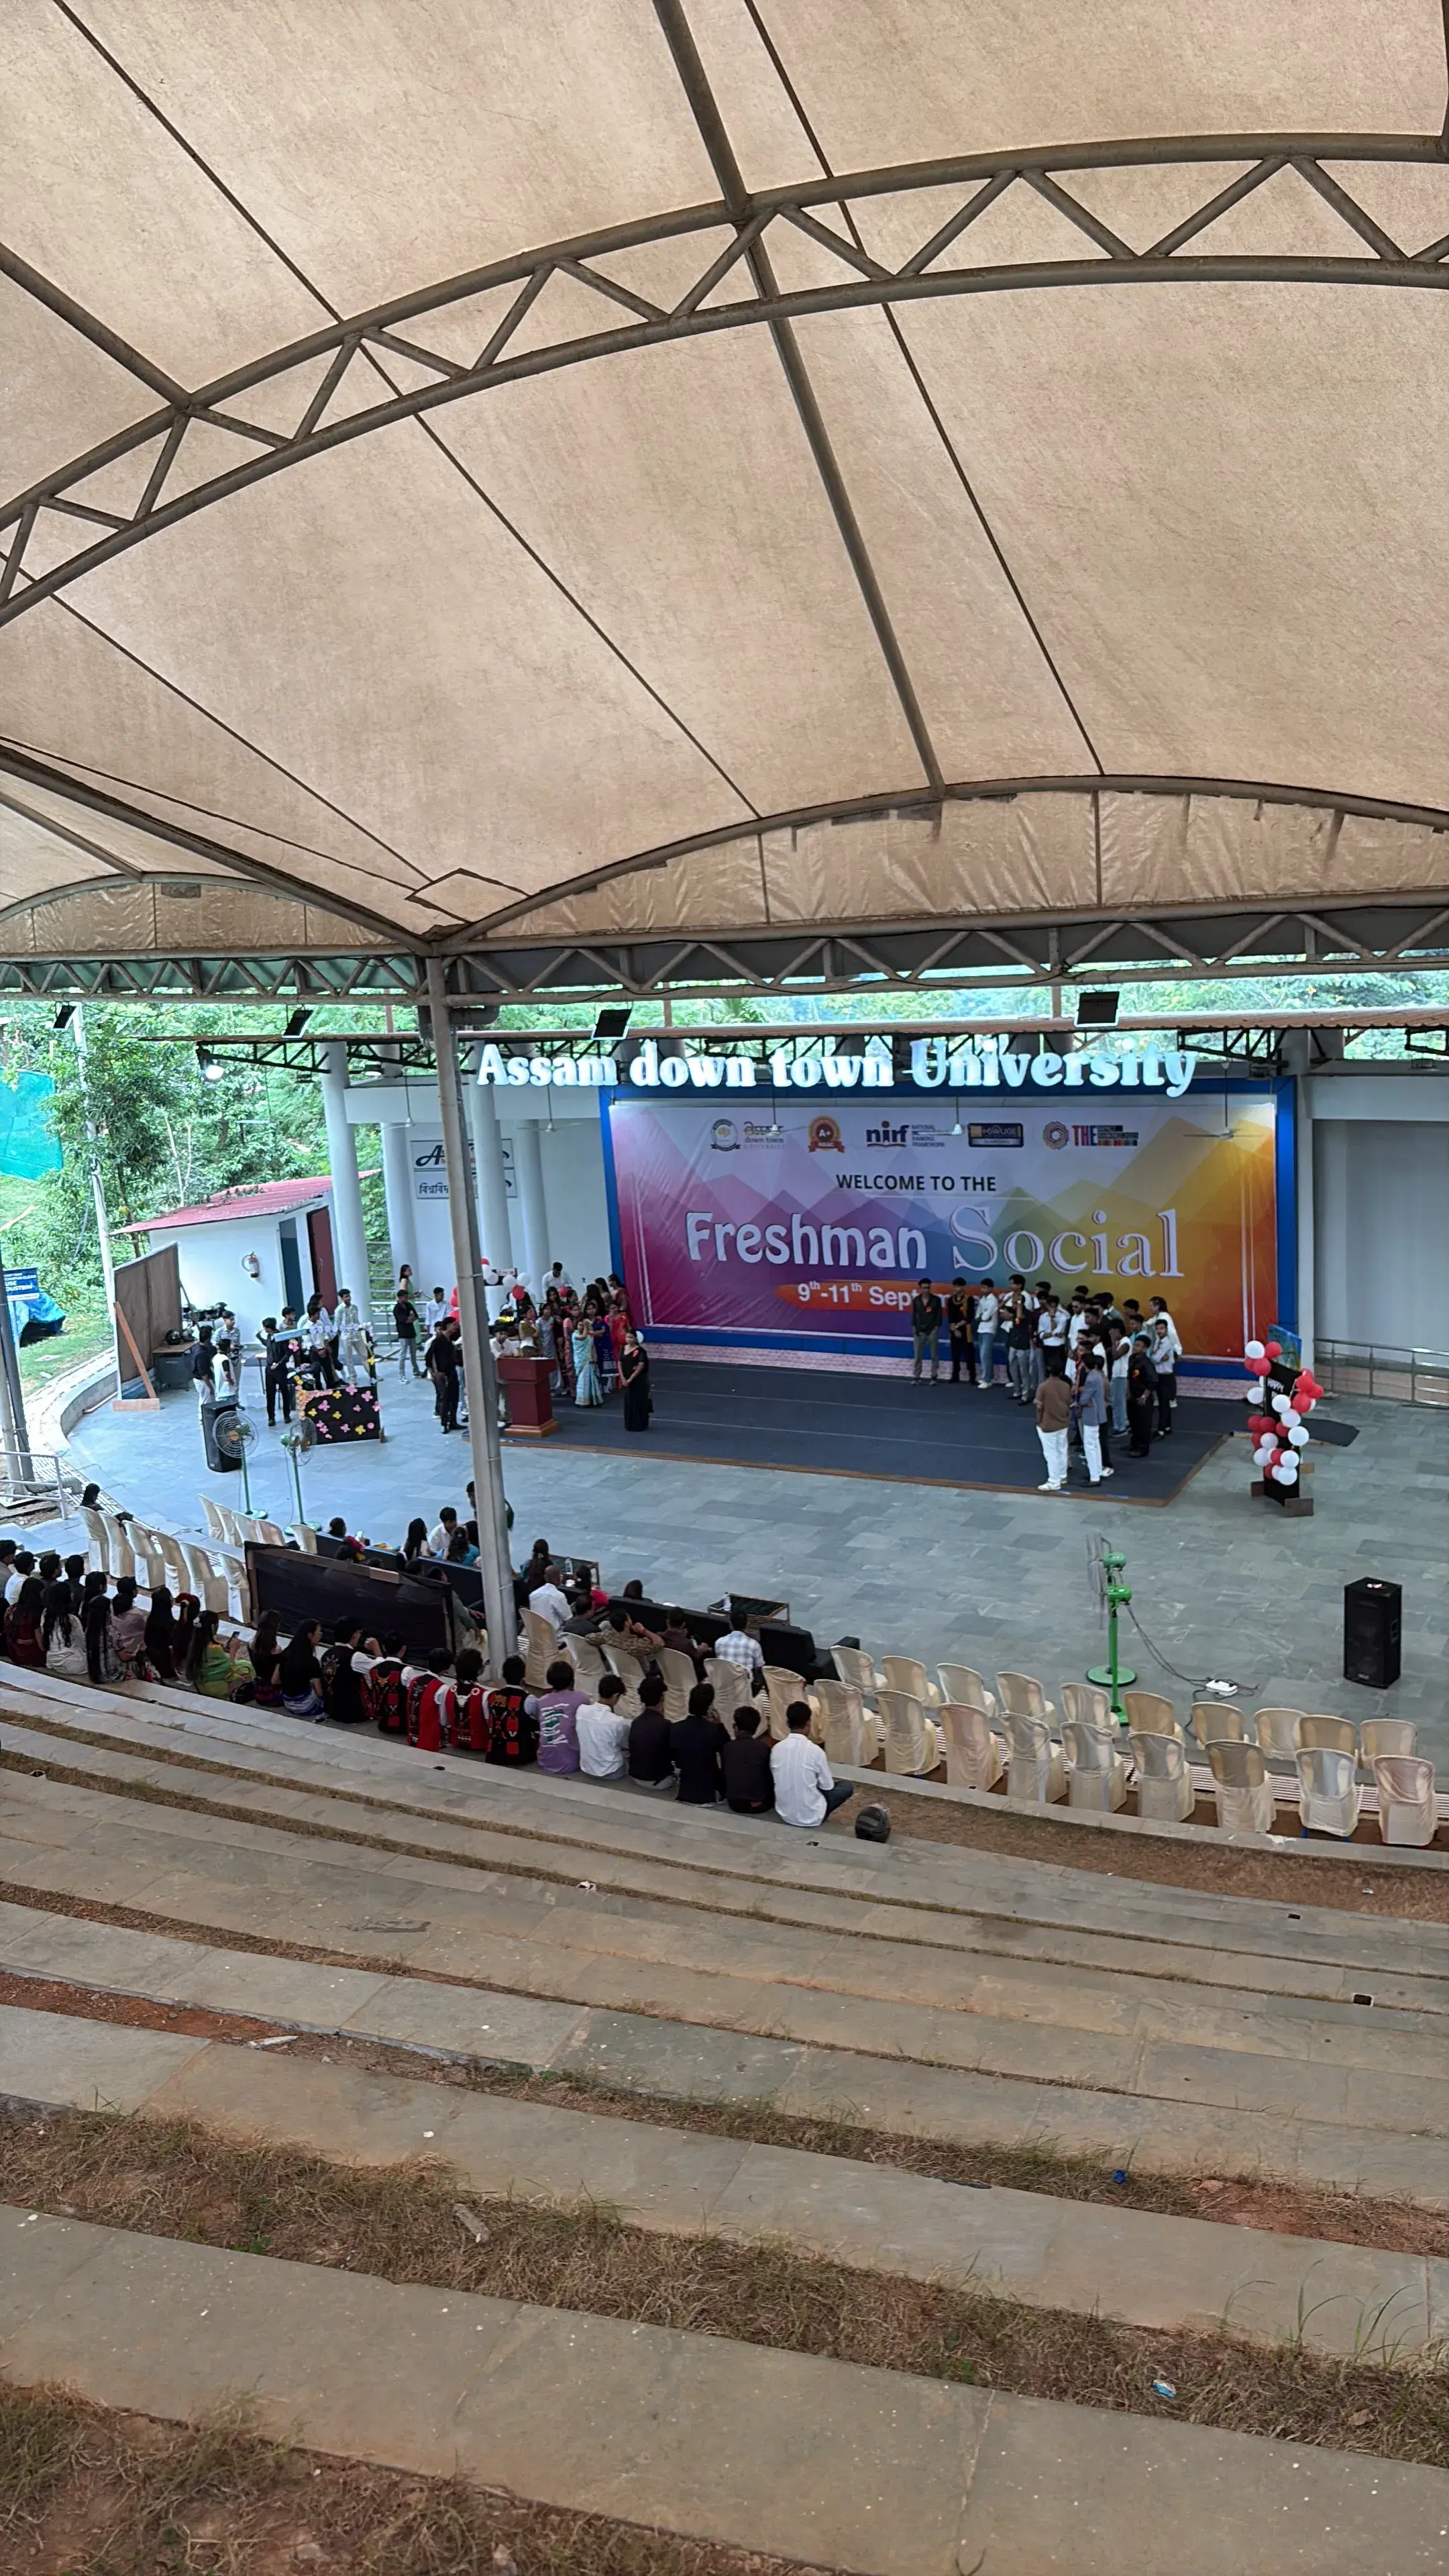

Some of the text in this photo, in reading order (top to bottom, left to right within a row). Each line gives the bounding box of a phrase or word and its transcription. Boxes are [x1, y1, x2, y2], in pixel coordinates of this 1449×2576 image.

[476, 1038, 1198, 1098] Assam down town University
[866, 1120, 910, 1143] nirf
[1071, 1125, 1098, 1146] THE
[836, 1174, 997, 1192] WELCOME TO THE
[686, 1205, 1185, 1277] Freshman Social
